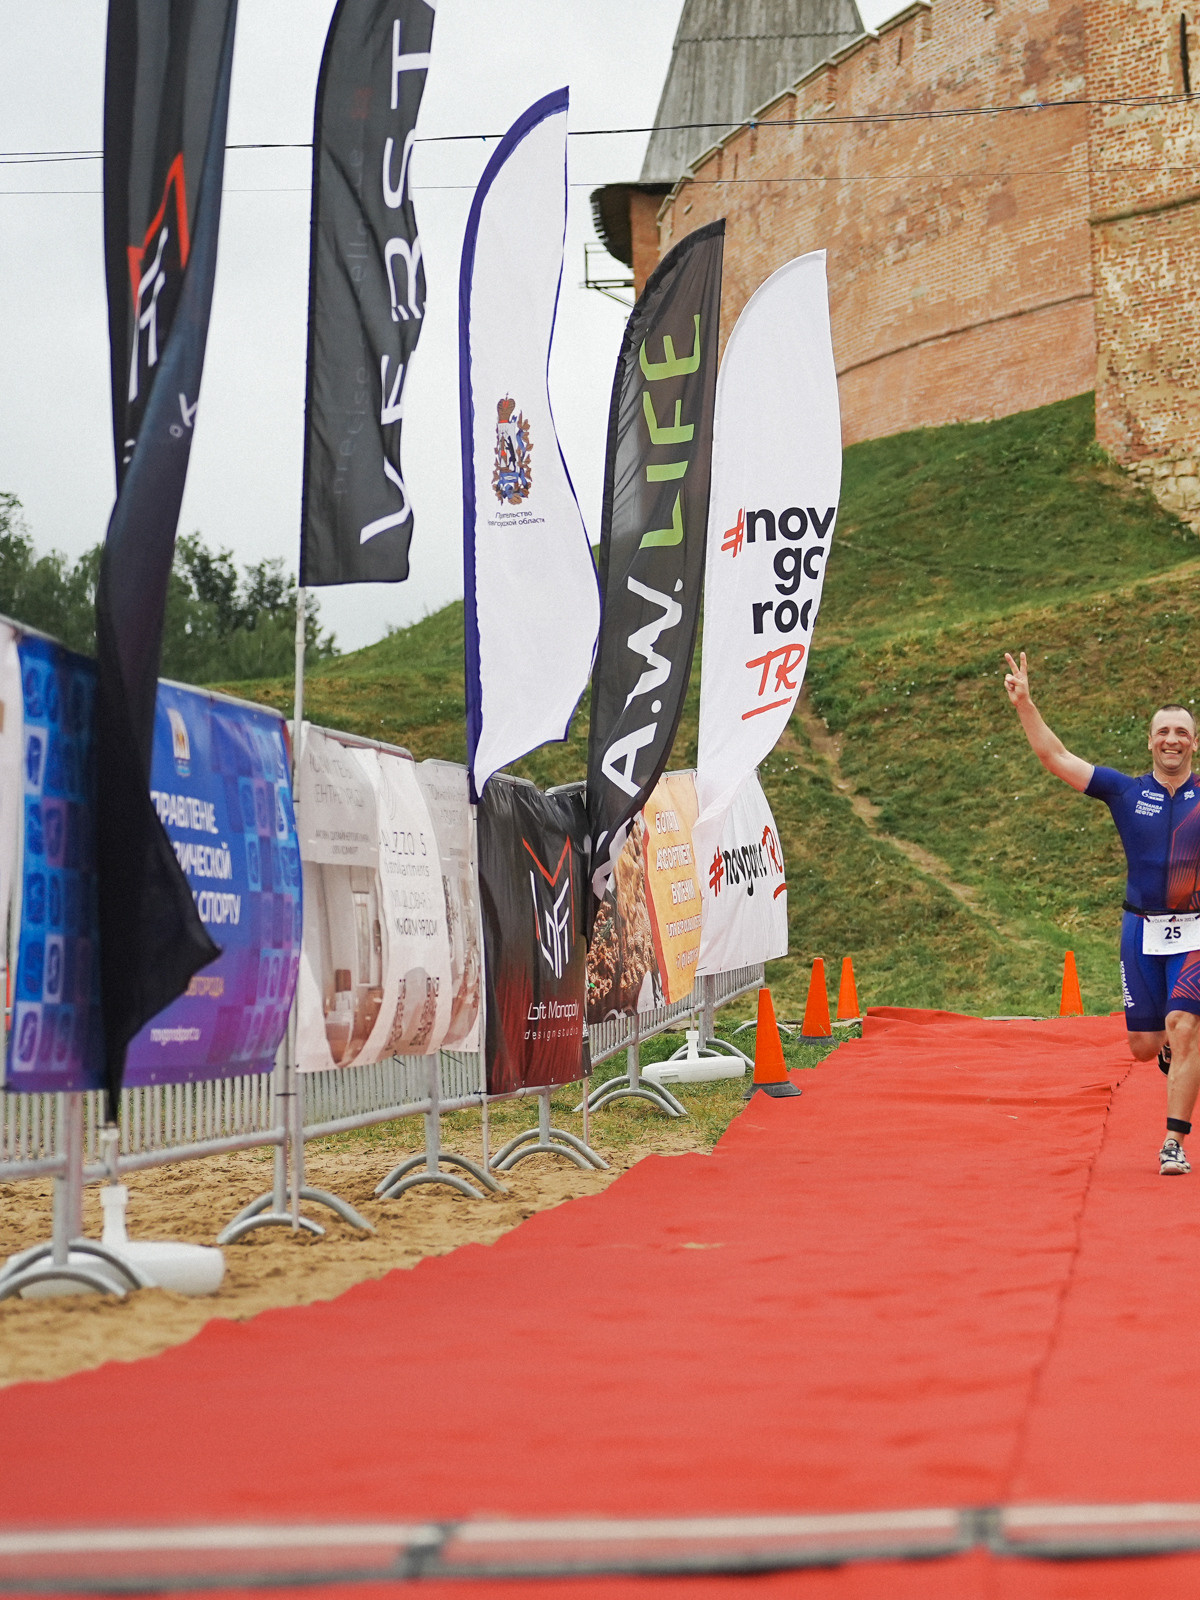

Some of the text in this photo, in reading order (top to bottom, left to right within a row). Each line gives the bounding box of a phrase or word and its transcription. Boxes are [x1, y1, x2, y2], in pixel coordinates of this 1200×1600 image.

[639, 315, 701, 550] LIFE
[721, 506, 836, 558] #nov
[1136, 804, 1161, 814] ГАЗПРОМ
[1137, 800, 1163, 811] КОМАНДА
[1164, 926, 1182, 940] 25
[528, 1001, 547, 1020] Loft
